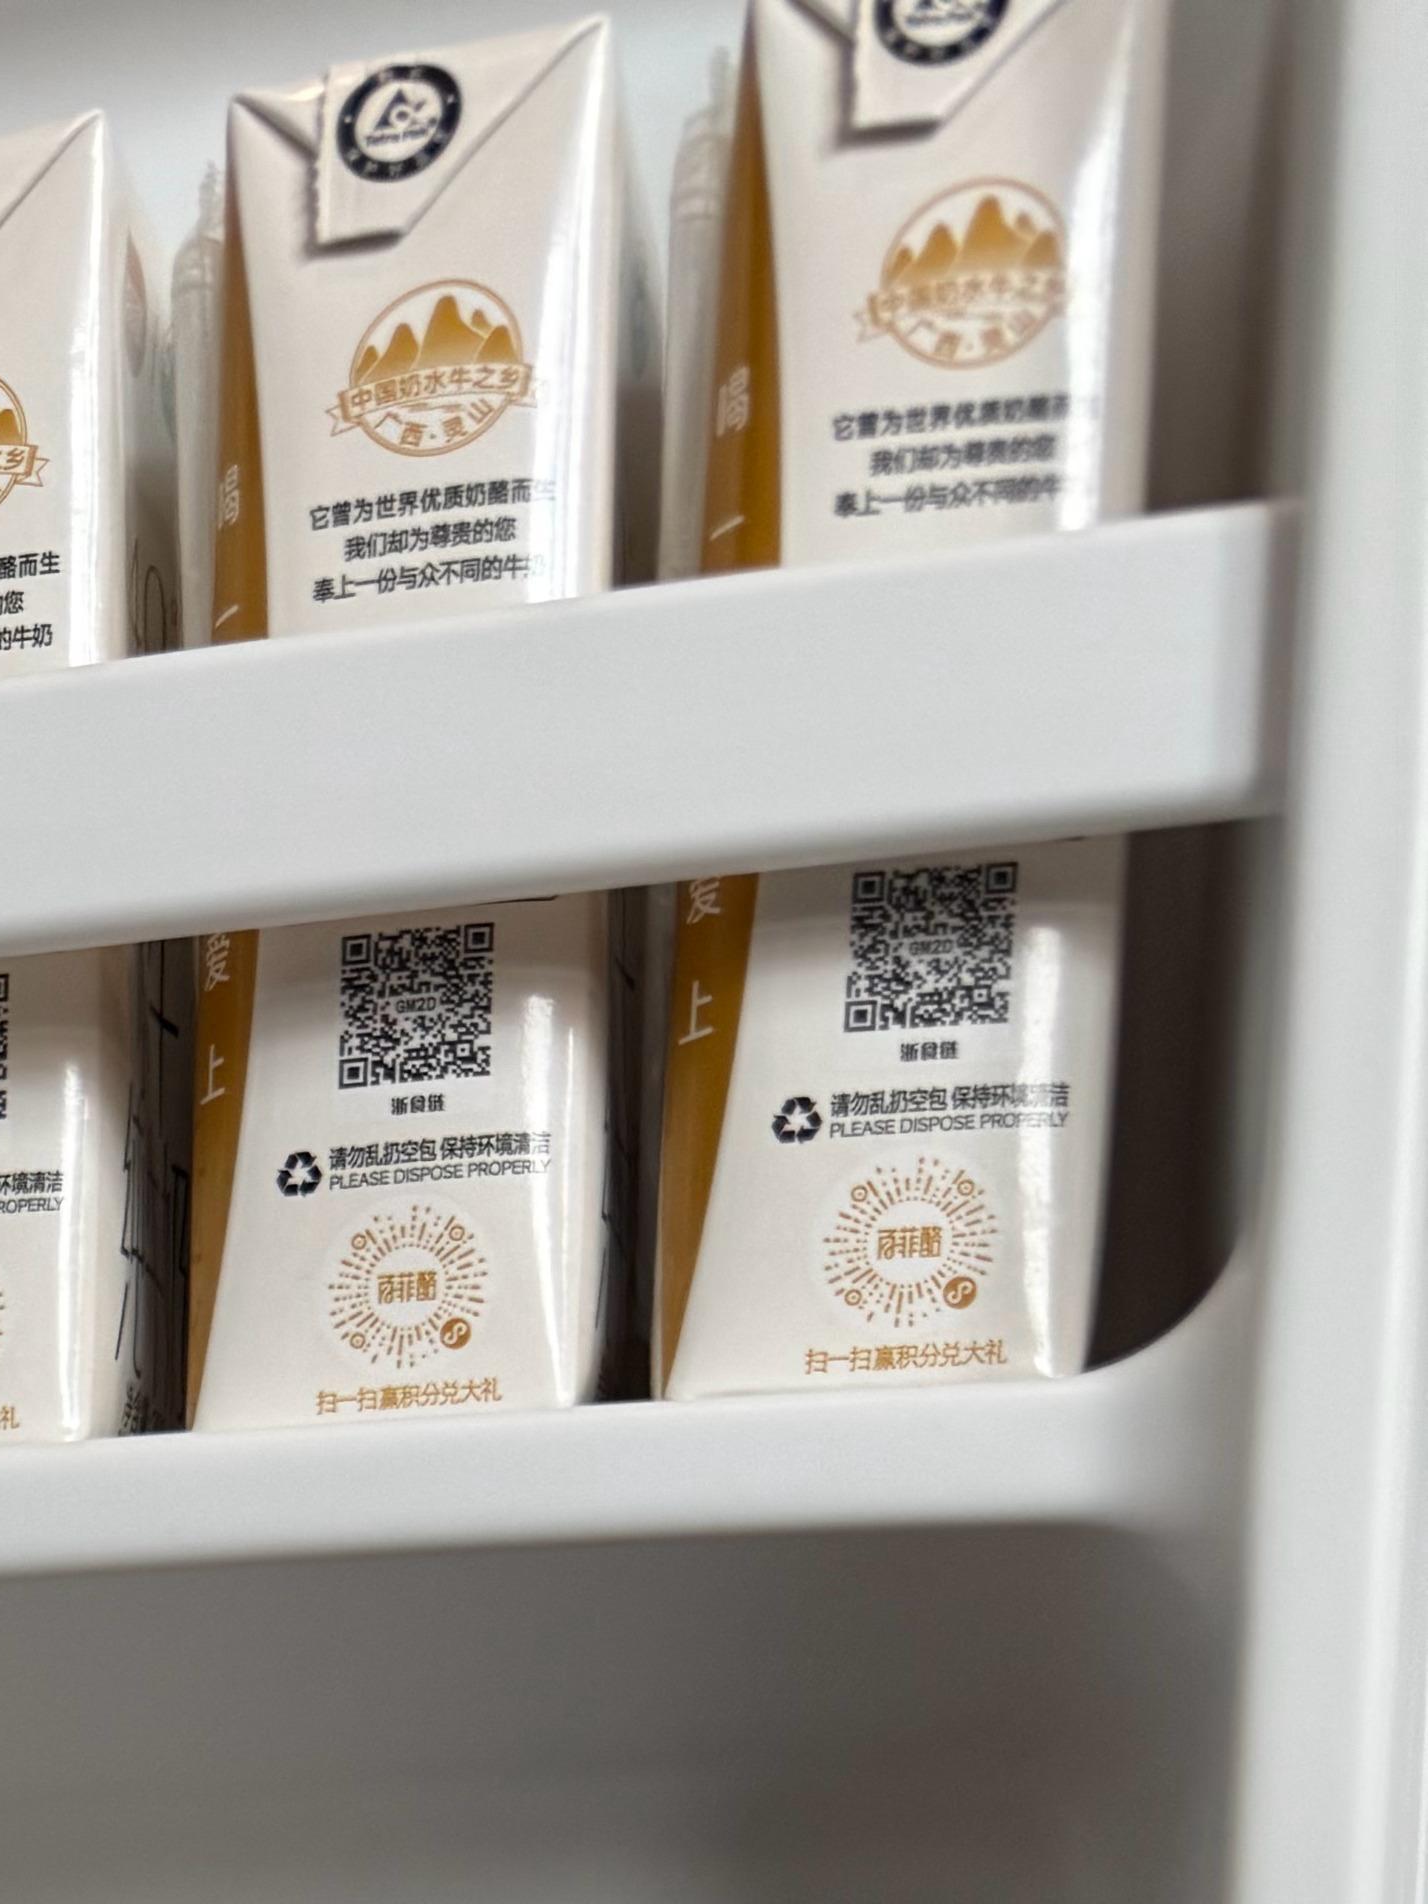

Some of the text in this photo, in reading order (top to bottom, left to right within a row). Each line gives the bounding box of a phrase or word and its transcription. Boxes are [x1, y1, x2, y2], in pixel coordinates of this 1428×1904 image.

[351, 366, 521, 411] 中国奶水牛之乡
[345, 516, 516, 562] 我们却为尊贵的您
[830, 1088, 947, 1117] 请勿乱扔空包
[830, 1119, 895, 1138] PLEASE
[900, 1115, 975, 1134] DISPOSE
[329, 1139, 436, 1170] 请勿乱扔空包
[330, 1159, 551, 1191] PLEASE DISPOSE PROPERLY
[805, 1339, 1008, 1375] 扫一扫赢积分兑大礼
[317, 1377, 502, 1415] 扫一扫赢积分兑大礼
